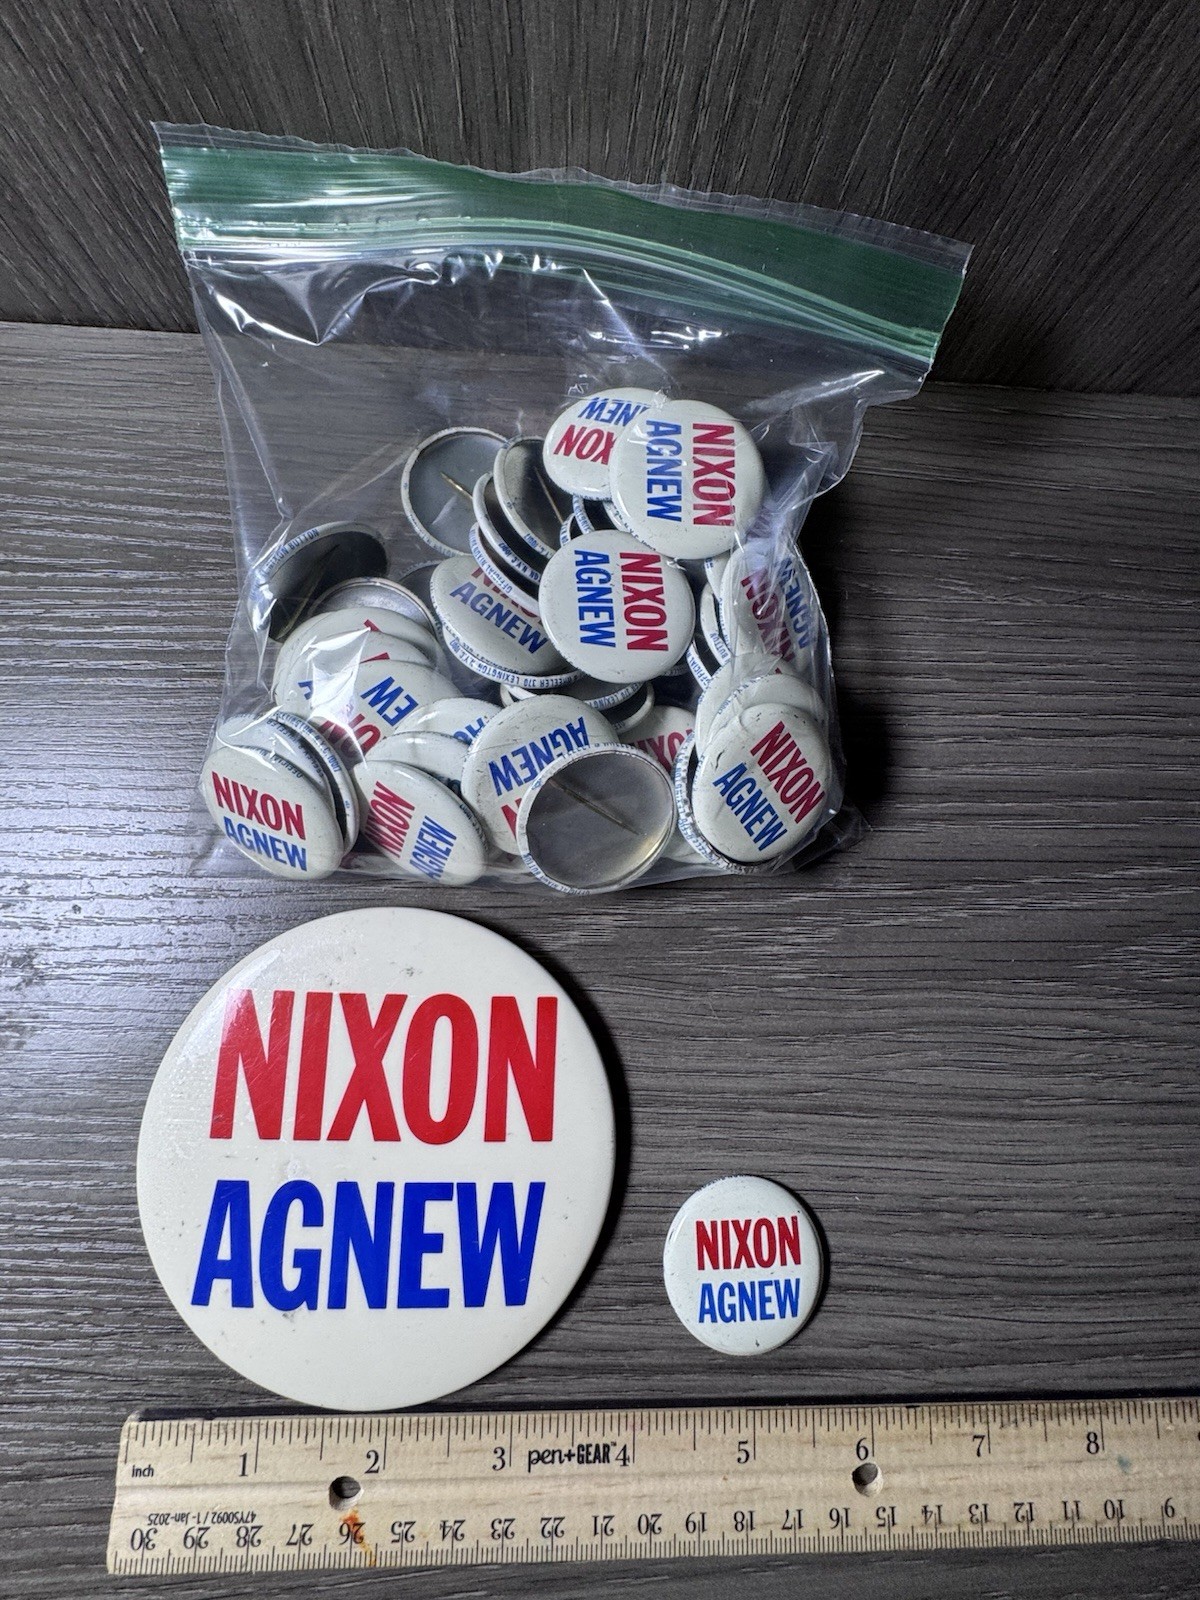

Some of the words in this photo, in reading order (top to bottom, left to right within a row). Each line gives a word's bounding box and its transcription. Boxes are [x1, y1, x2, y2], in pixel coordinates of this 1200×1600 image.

[578, 397, 650, 427] NEW
[553, 424, 617, 465] XON
[646, 420, 682, 522] AGNEW
[692, 423, 736, 526] NIXON
[289, 528, 320, 551] BUTTON
[485, 564, 513, 594] OFFICIAL
[574, 550, 616, 648] AGNEW
[620, 552, 669, 651] NIXON
[449, 581, 547, 654] AGNEW
[477, 664, 520, 683] LEXINGTON
[523, 677, 538, 688] 370
[488, 716, 590, 797] AGNEW
[750, 721, 825, 824] NIXON
[212, 771, 306, 840] NIXON
[712, 762, 788, 851] AGNEW
[364, 781, 415, 858] NIXON
[223, 816, 307, 871] AGNEW
[409, 815, 457, 880] AGNEW
[209, 989, 558, 1145] NIXON
[191, 1179, 546, 1310] AGNEW
[696, 1216, 801, 1270] NIXON
[698, 1278, 800, 1323] AGNEW
[239, 1453, 248, 1476] 1
[365, 1450, 379, 1473] 2
[492, 1447, 506, 1470] 3
[615, 1444, 630, 1466] 4
[737, 1440, 750, 1463] 5
[856, 1438, 868, 1460] 6
[972, 1434, 985, 1457] 7
[1086, 1431, 1099, 1454] 8
[132, 1464, 154, 1477] inch
[829, 1508, 850, 1528] 16
[876, 1506, 897, 1527] 15
[921, 1504, 943, 1525] 14
[968, 1503, 991, 1523] 13
[1014, 1502, 1034, 1523] 12
[1062, 1500, 1081, 1520] 11
[1104, 1499, 1126, 1520] 10
[1165, 1498, 1175, 1518] 9
[440, 1519, 466, 1541] 24
[490, 1518, 516, 1540] 23
[540, 1517, 565, 1537] 22
[592, 1515, 615, 1536] 21
[638, 1513, 662, 1535] 20
[686, 1511, 707, 1534] 19
[734, 1510, 756, 1531] 18
[782, 1509, 804, 1530] 17
[131, 1528, 157, 1550] 30
[184, 1526, 210, 1548] 29
[237, 1525, 263, 1547] 28
[286, 1524, 314, 1545] 27
[339, 1522, 365, 1543] 26
[391, 1521, 416, 1542] 25
